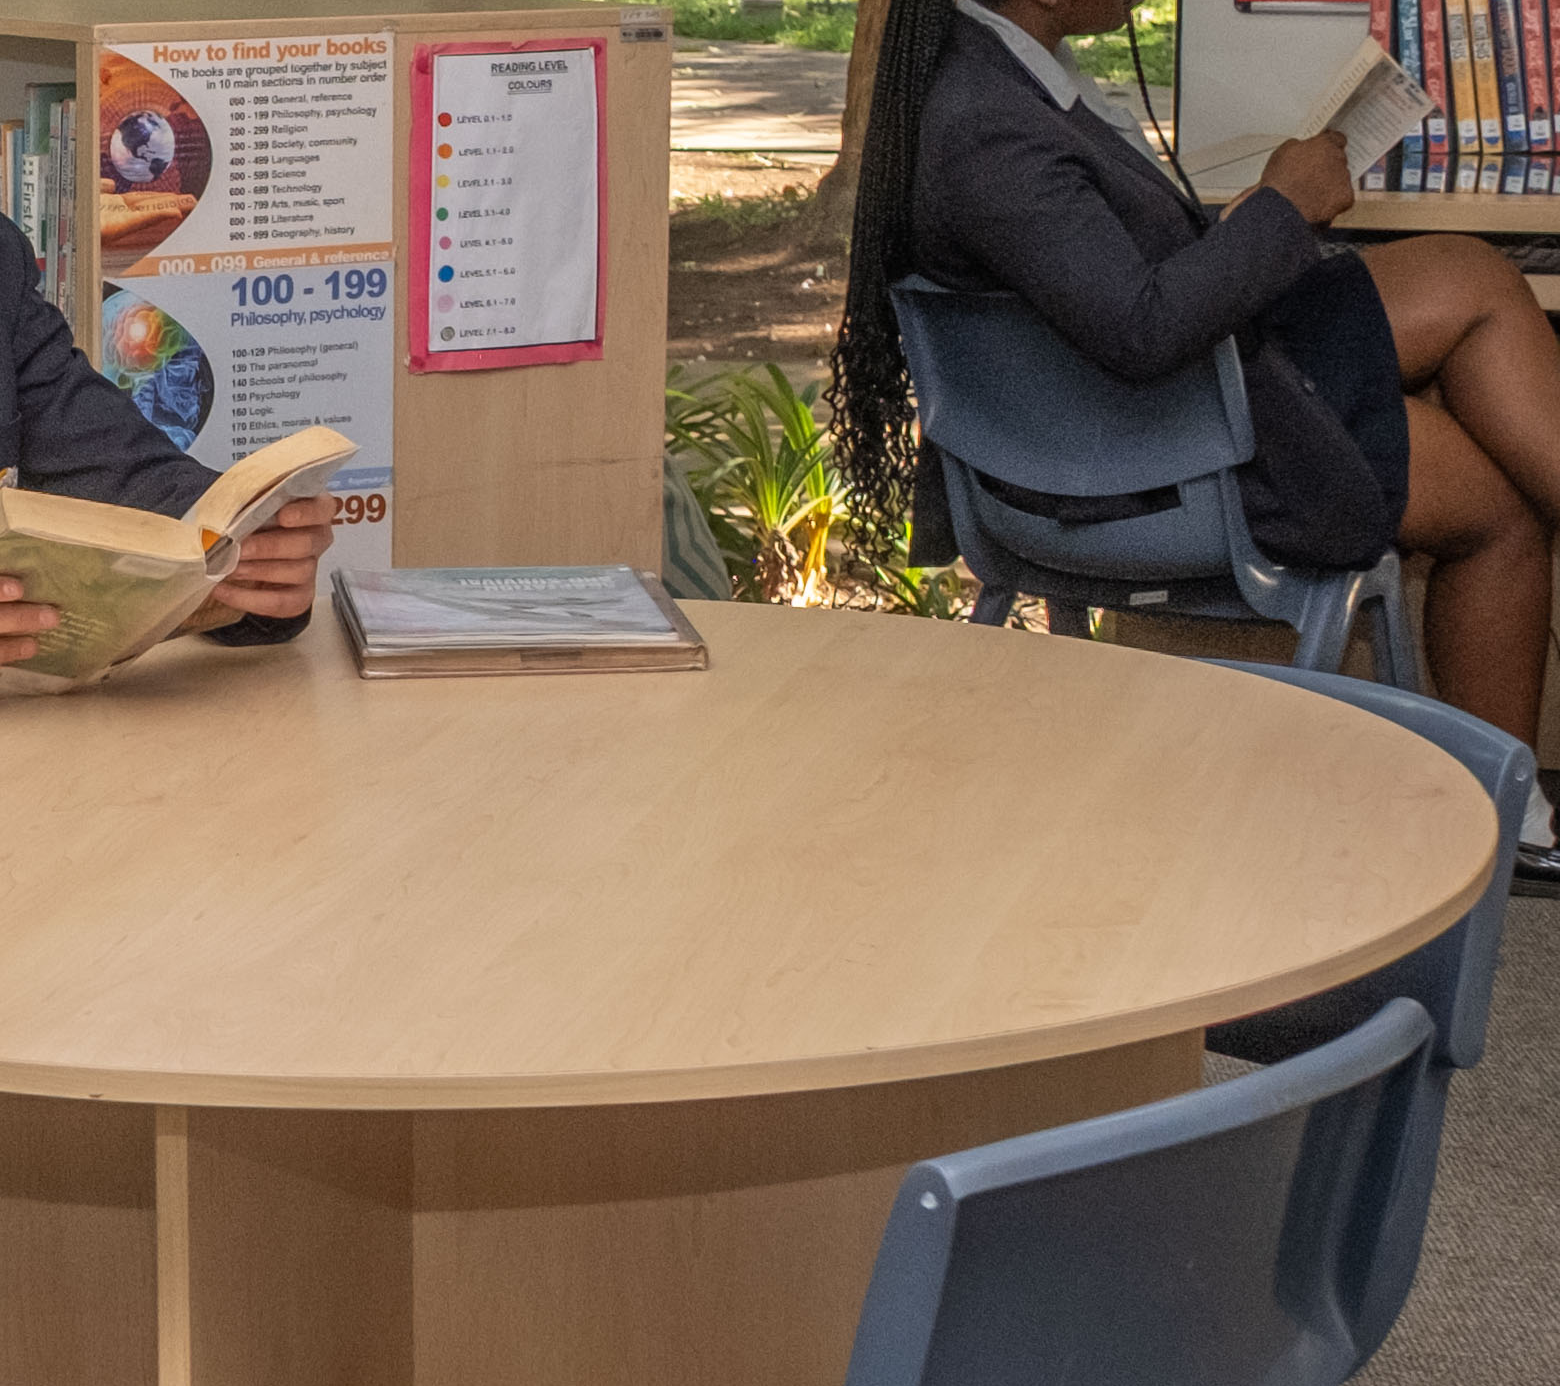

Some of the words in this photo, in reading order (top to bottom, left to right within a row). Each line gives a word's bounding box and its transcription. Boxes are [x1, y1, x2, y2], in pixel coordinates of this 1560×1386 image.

[153, 45, 201, 63] How
[206, 44, 227, 61] to
[232, 41, 270, 60] find
[276, 43, 321, 63] your
[326, 37, 387, 56] books
[169, 67, 189, 79] The
[191, 66, 224, 78] books
[226, 67, 243, 77] are
[245, 64, 288, 78] grouped
[290, 61, 332, 76] together
[335, 60, 347, 74] by
[349, 59, 387, 73] subject
[491, 61, 536, 74] READING
[539, 59, 568, 72] LEVEL
[206, 79, 216, 90] in
[219, 79, 231, 89] 10
[233, 78, 259, 89] main
[261, 76, 304, 87] sections
[306, 75, 316, 86] in
[318, 74, 357, 85] number
[360, 72, 387, 83] order
[272, 124, 308, 135] Religion
[324, 225, 355, 235] history
[158, 258, 195, 276] 000
[210, 255, 247, 273] 099
[253, 252, 306, 268] General
[311, 252, 321, 264] &
[324, 249, 390, 263] reference
[231, 274, 294, 307] 100
[324, 268, 387, 300] 199
[231, 309, 307, 327] Philosophy,
[309, 305, 387, 324] psychology
[249, 390, 301, 402] Psychology
[331, 493, 386, 525] 299
